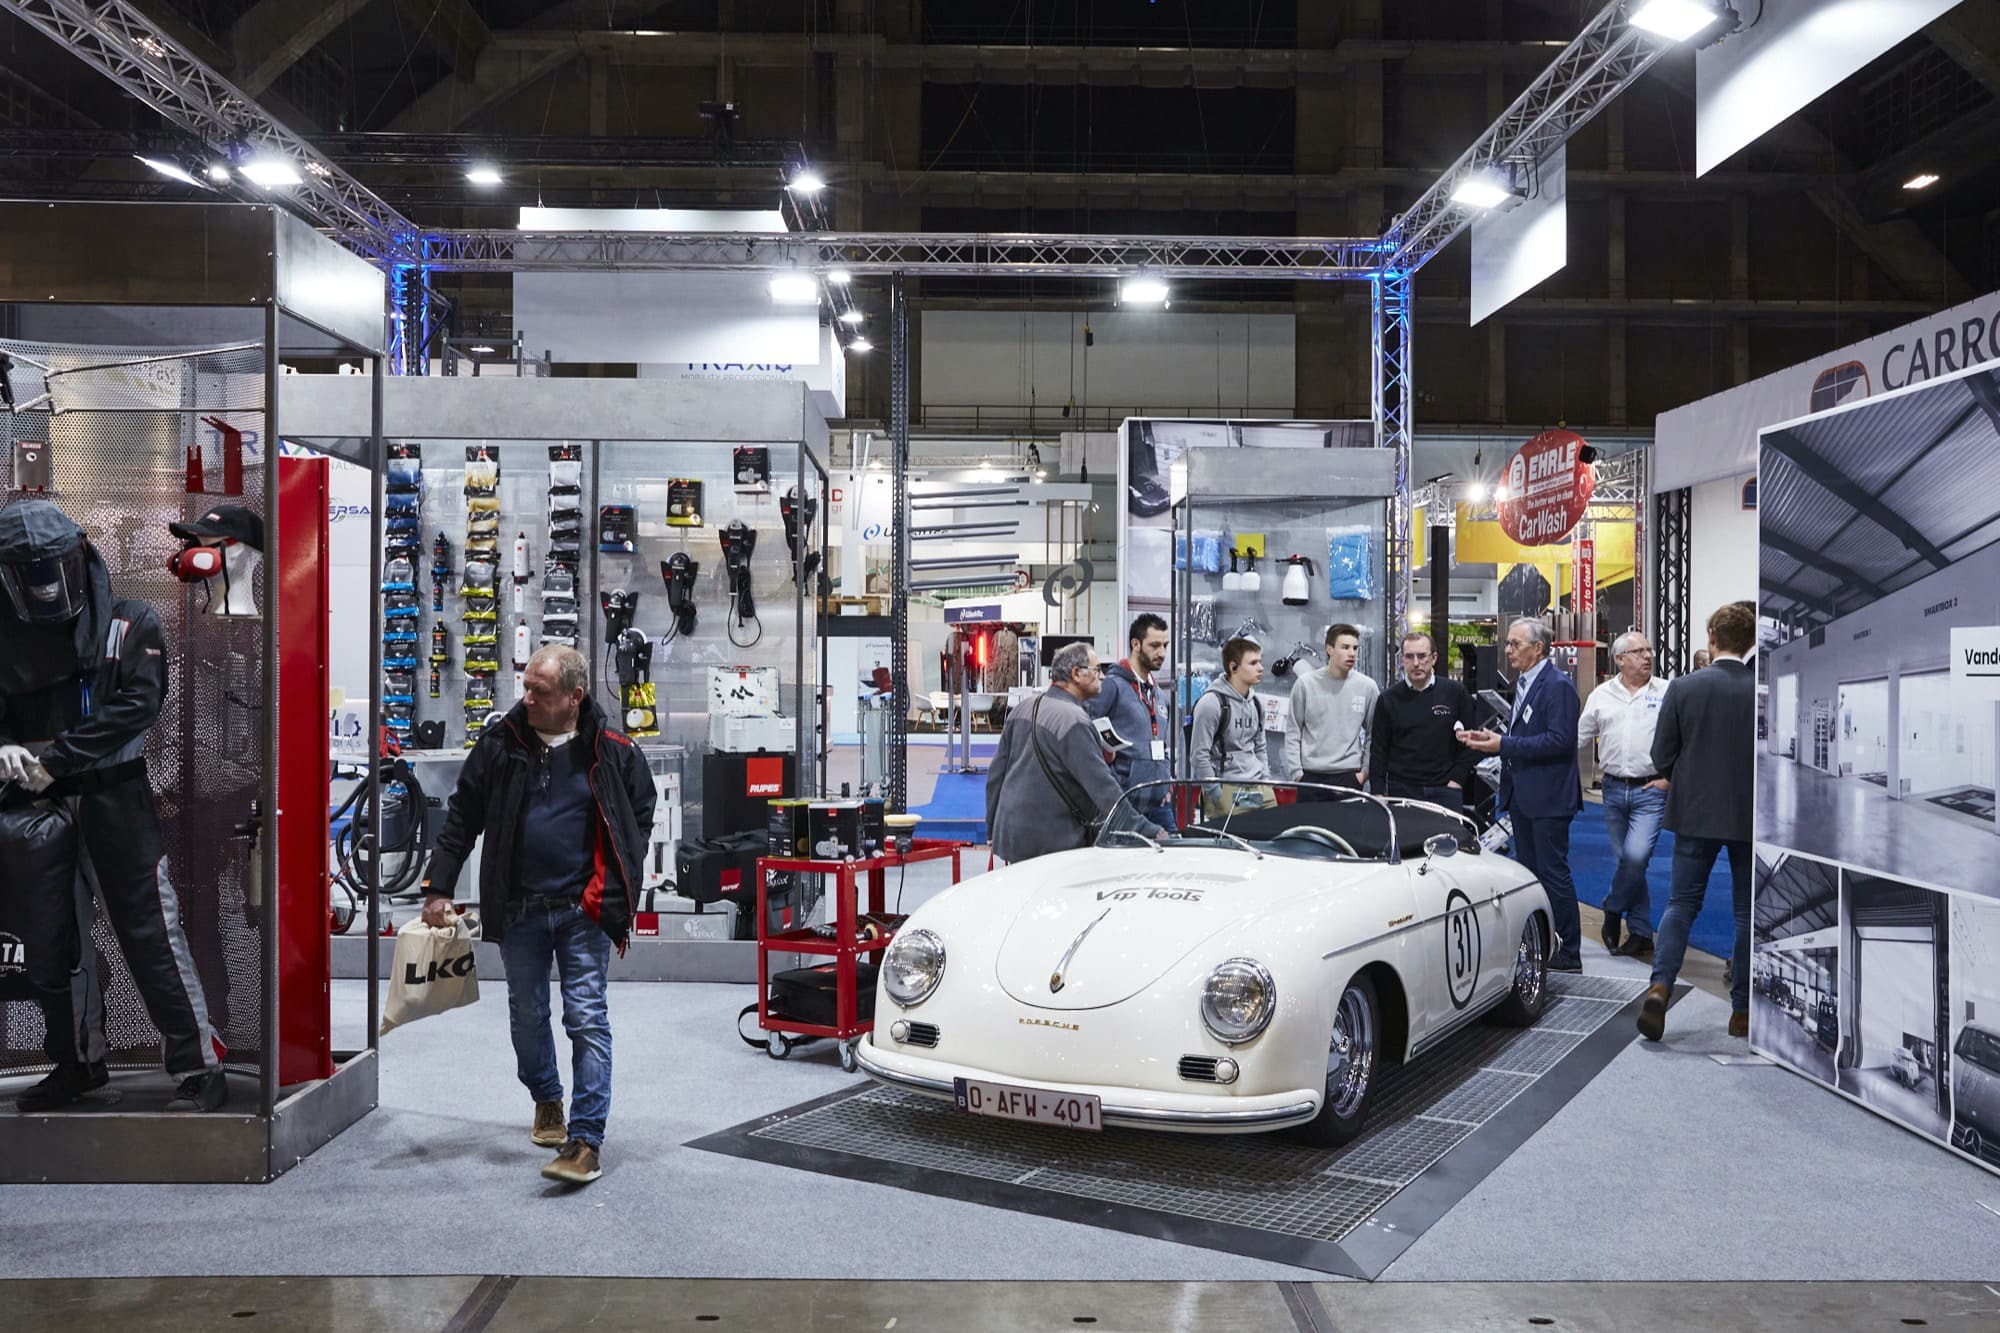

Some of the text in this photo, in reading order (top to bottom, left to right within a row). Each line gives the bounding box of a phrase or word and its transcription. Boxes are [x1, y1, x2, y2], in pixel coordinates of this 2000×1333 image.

[1528, 441, 1576, 482] EHRLE
[1519, 505, 1567, 540] CarWash
[1583, 563, 1592, 588] clean
[1965, 648, 2000, 665] Vand
[749, 783, 781, 793] RUPES
[1096, 887, 1206, 902] Vip Tools
[1453, 910, 1472, 979] 31
[1018, 1017, 1080, 1031] PORSCHE
[958, 1095, 966, 1107] B
